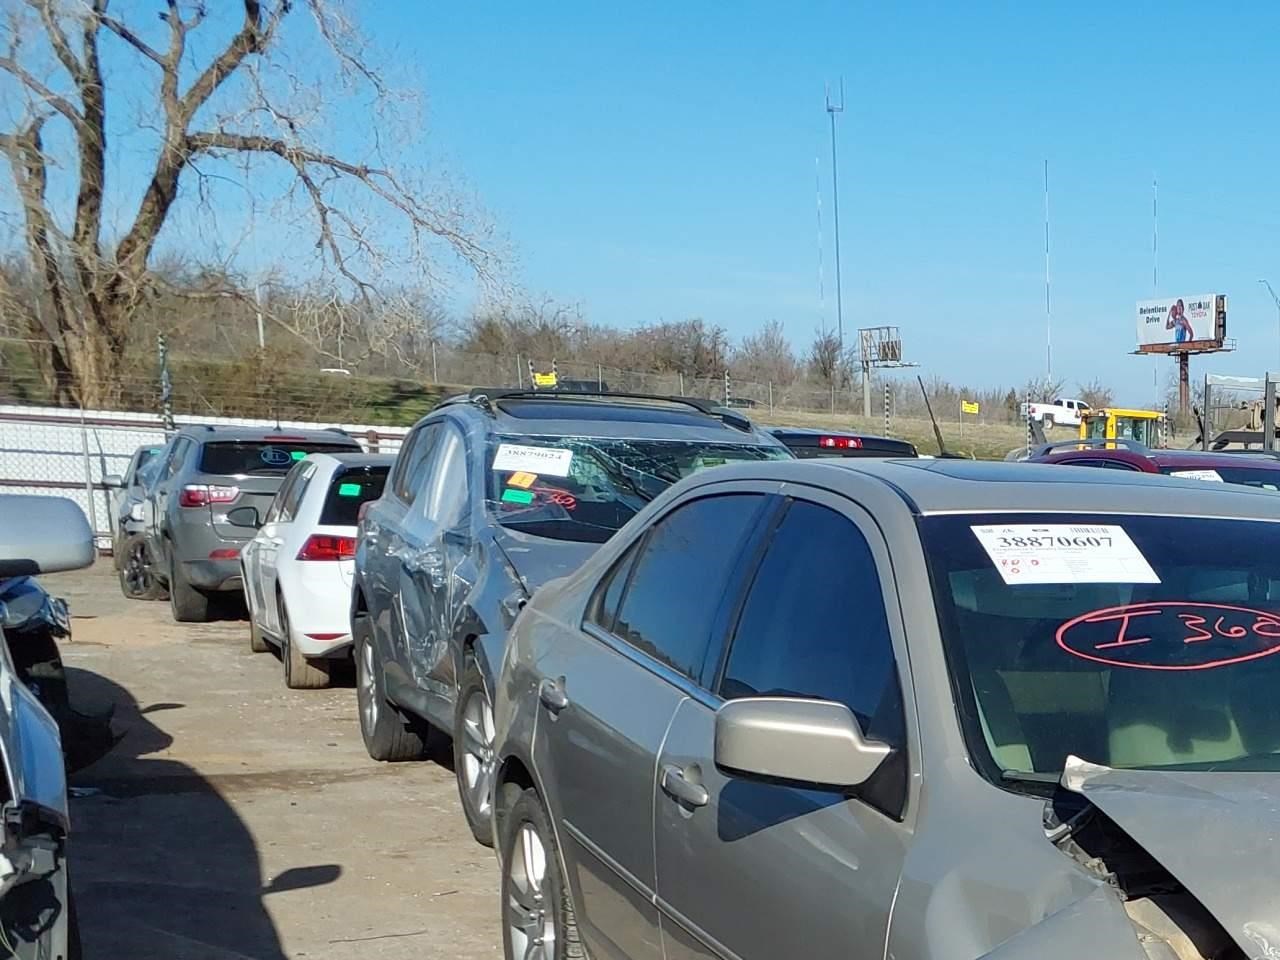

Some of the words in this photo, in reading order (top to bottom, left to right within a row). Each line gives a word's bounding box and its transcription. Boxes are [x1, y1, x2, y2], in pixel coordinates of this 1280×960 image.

[1139, 305, 1168, 315] Relentless
[1191, 311, 1208, 319] TOYOTA
[1145, 316, 1161, 324] Drive
[996, 536, 1112, 548] 38870607
